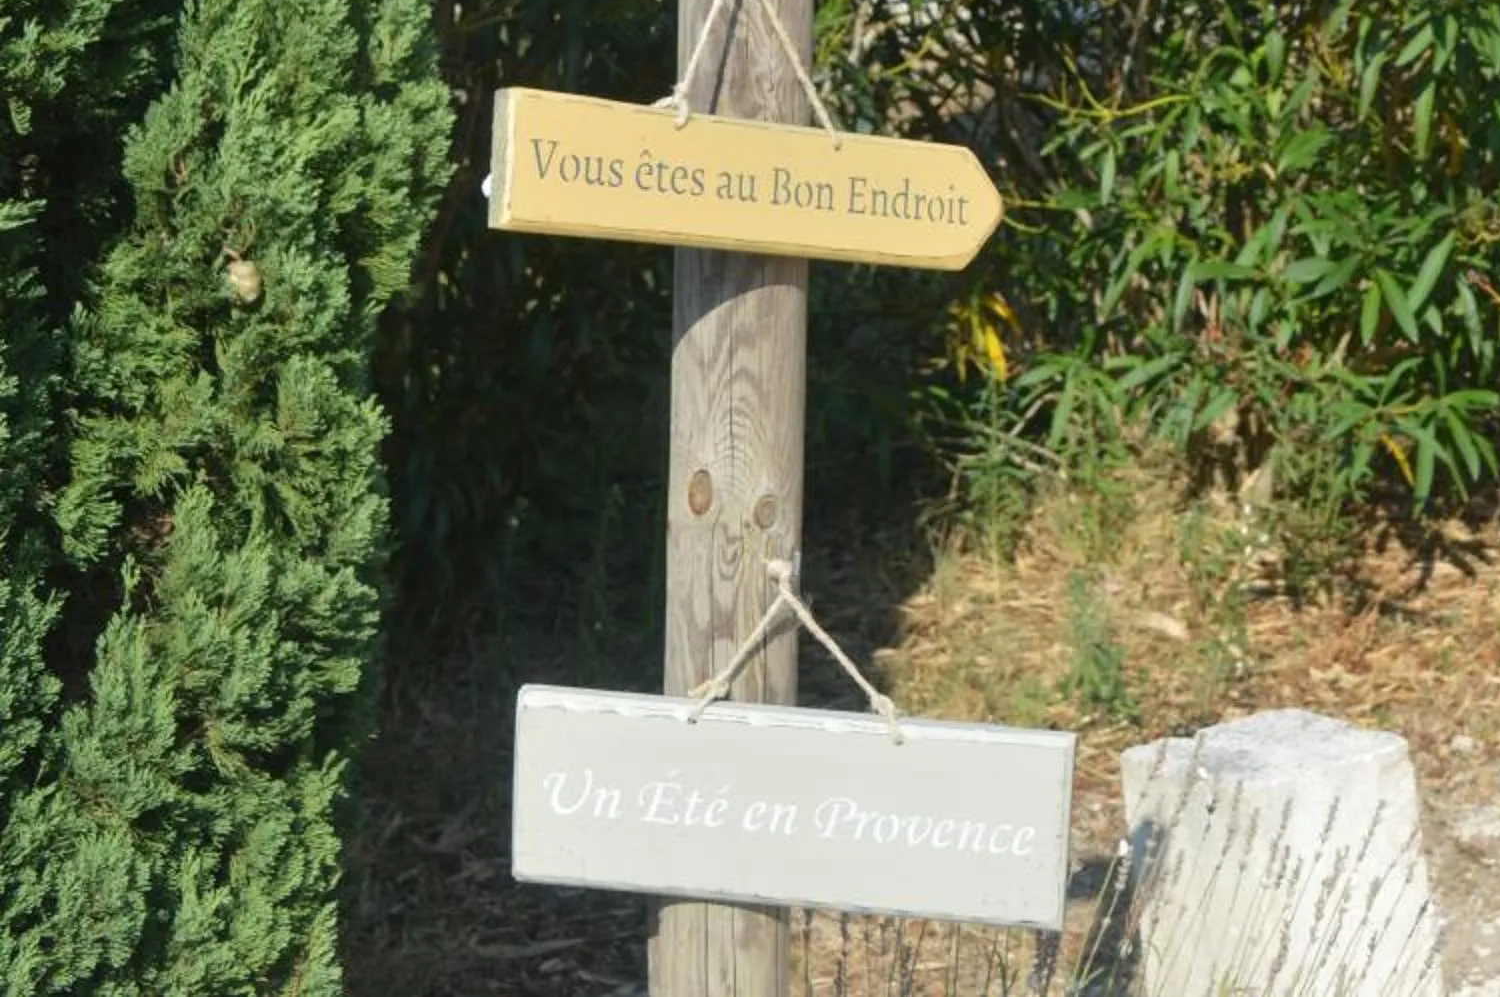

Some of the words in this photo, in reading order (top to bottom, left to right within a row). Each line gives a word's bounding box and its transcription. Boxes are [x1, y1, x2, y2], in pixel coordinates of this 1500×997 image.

[530, 138, 624, 188] Vous
[635, 149, 705, 196] êtes
[716, 170, 757, 203] au
[770, 167, 834, 212] Bon
[847, 176, 969, 226] Endroit
[542, 768, 624, 819] Un
[638, 769, 730, 828] Été
[743, 799, 799, 836] en
[813, 796, 1037, 856] Provence
